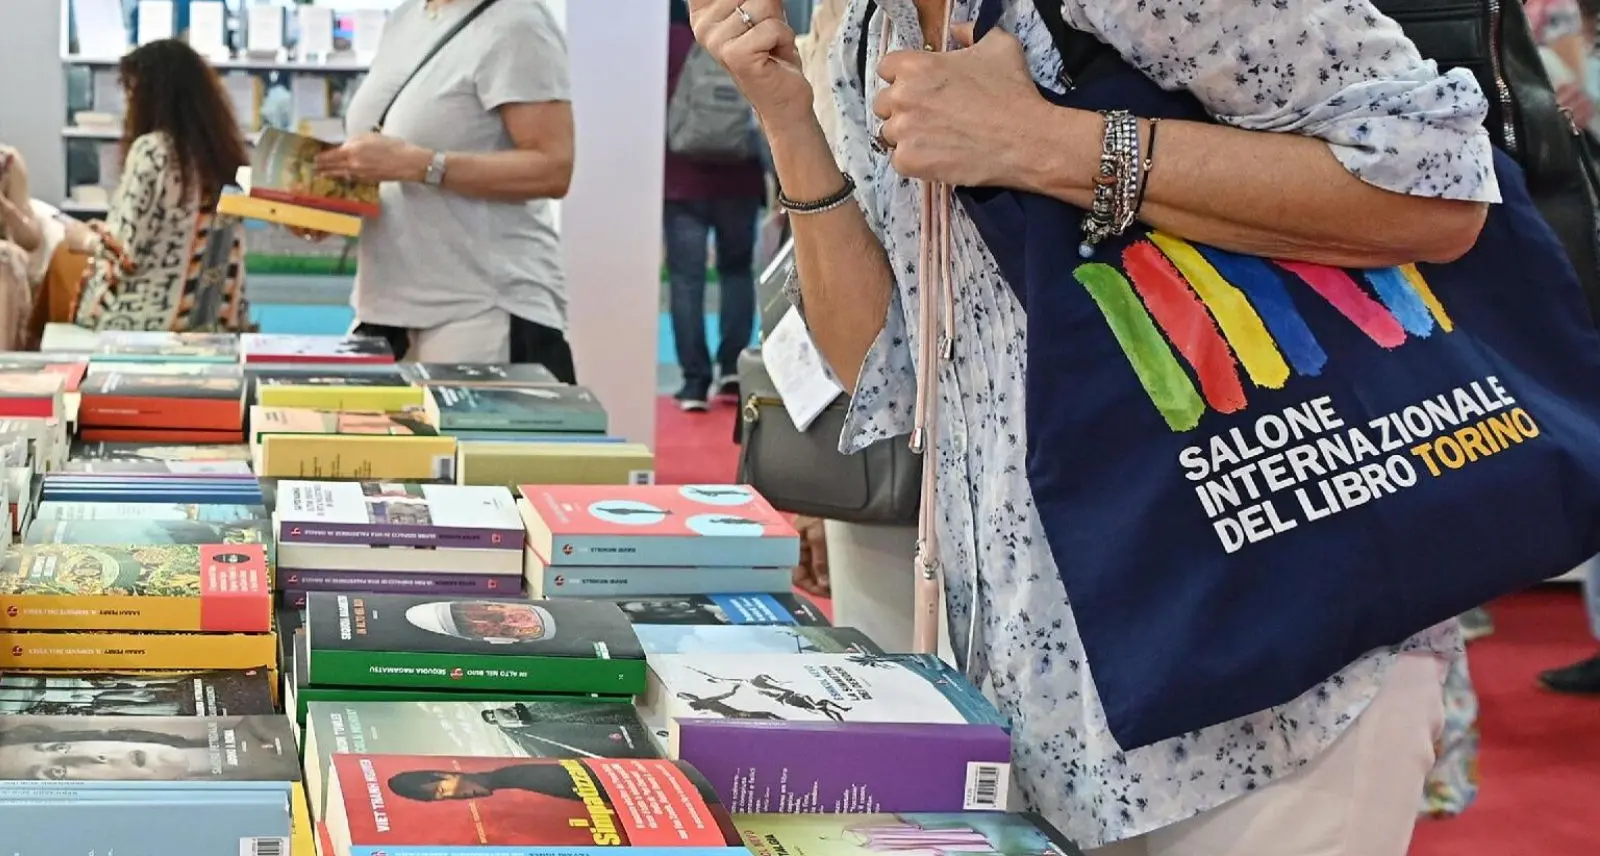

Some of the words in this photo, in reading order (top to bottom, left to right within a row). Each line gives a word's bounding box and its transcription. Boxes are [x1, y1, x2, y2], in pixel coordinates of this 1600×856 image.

[1179, 395, 1345, 482] SALONE
[1195, 376, 1516, 518] INTERNAZIONALE
[1212, 500, 1297, 554] DEL
[1294, 454, 1418, 523] LIBRO
[1411, 407, 1541, 477] TORINO
[416, 668, 446, 676] SEQUOIA
[374, 811, 390, 832] VIET
